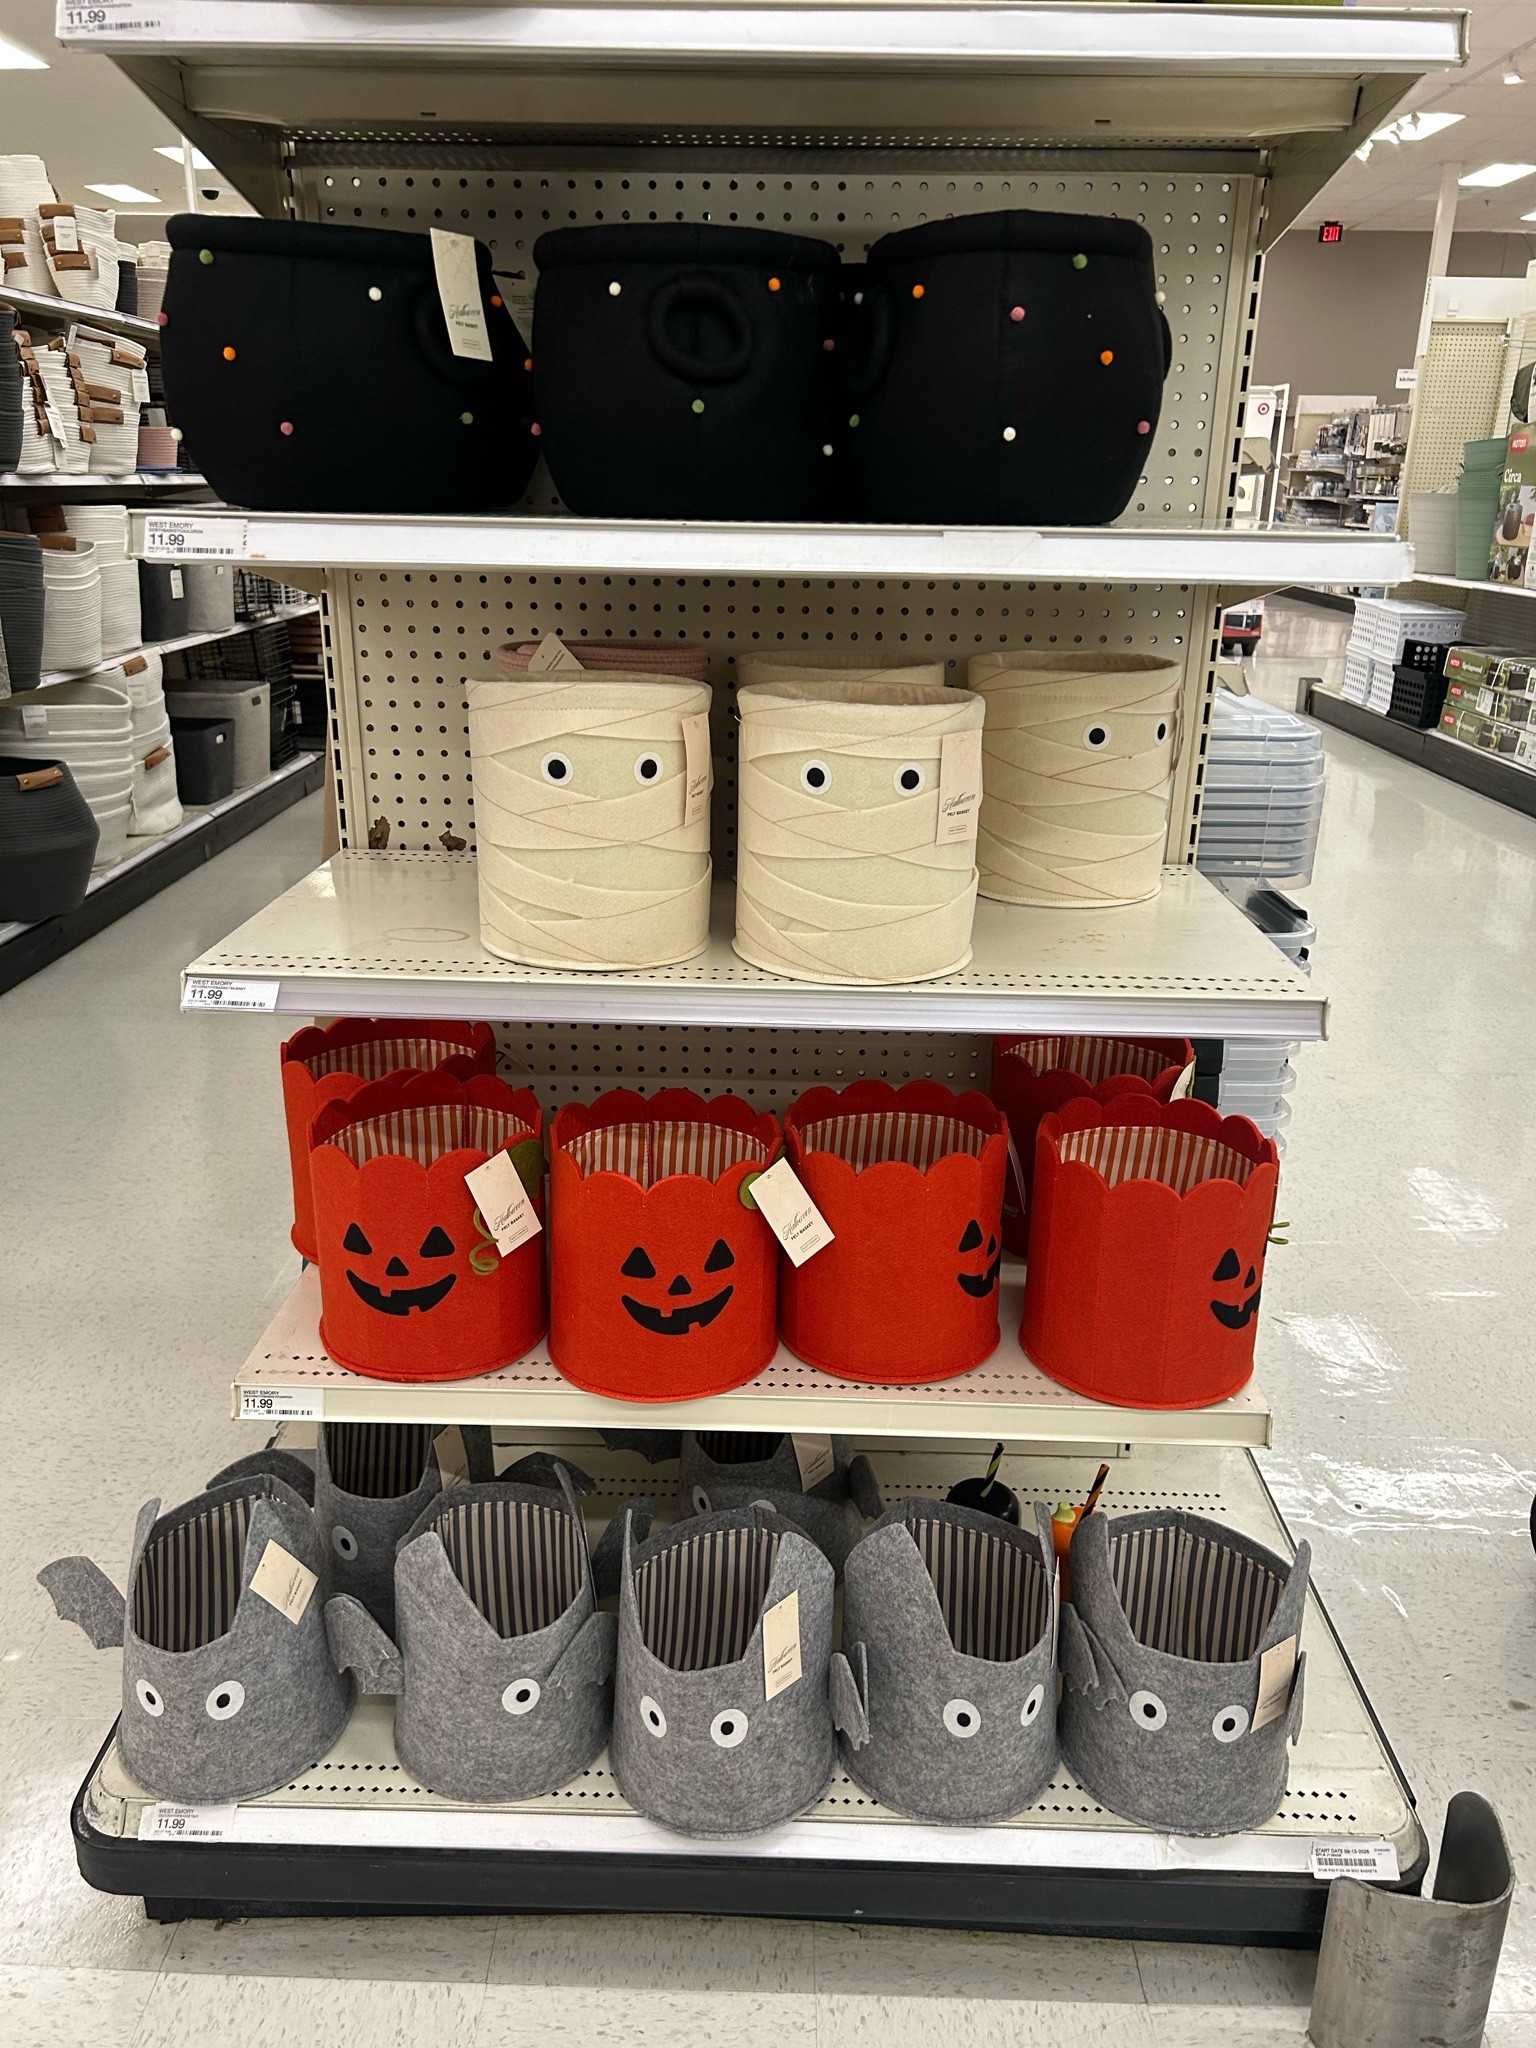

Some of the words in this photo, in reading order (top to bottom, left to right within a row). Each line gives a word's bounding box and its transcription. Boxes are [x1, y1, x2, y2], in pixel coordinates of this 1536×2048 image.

[67, 10, 106, 24] 11.99
[1323, 226, 1340, 241] EXIT
[1504, 468, 1522, 483] Circa
[150, 533, 185, 546] 11.99
[191, 989, 223, 999] 11.99
[790, 1232, 800, 1240] FELT
[799, 1221, 814, 1234] BASKET
[245, 1398, 273, 1409] 11.99
[158, 1819, 186, 1829] 11.99
